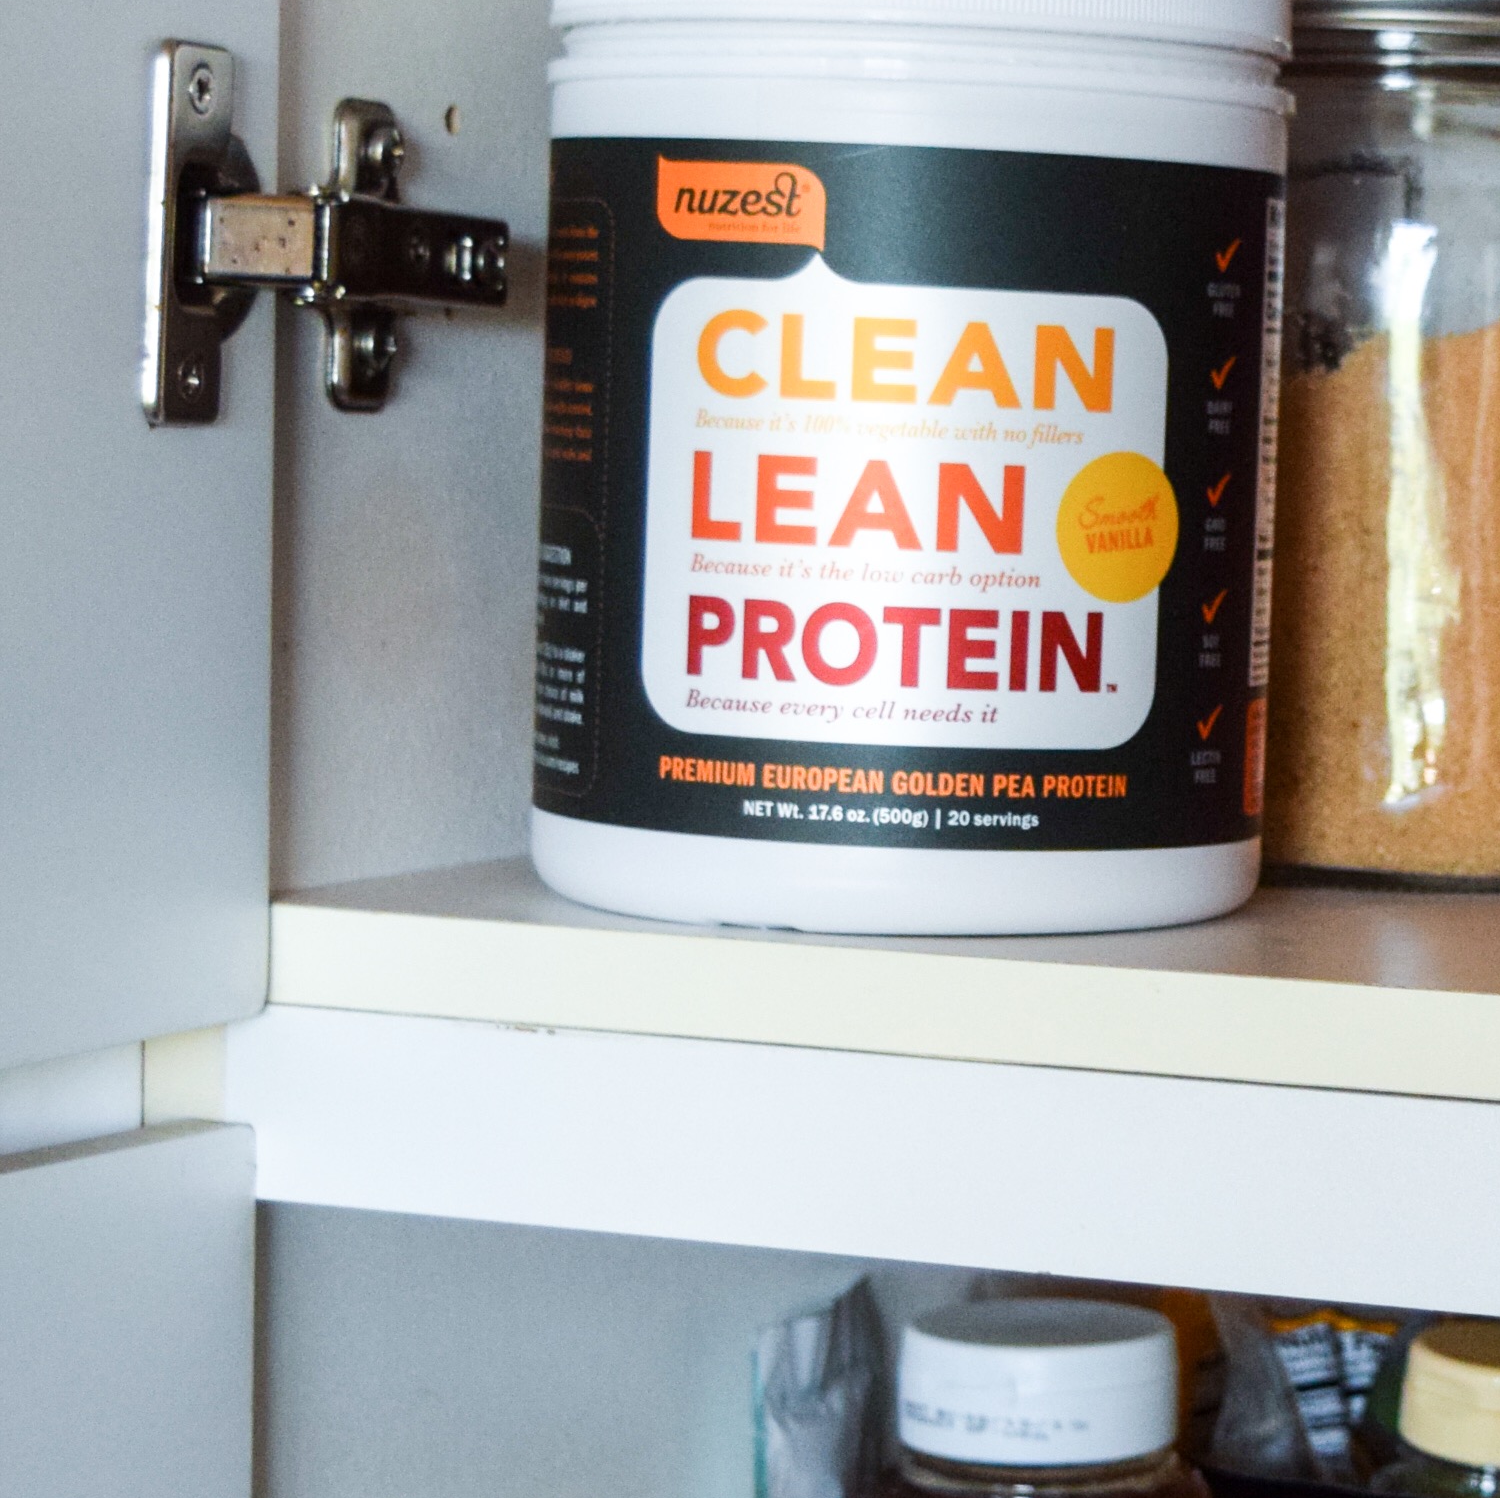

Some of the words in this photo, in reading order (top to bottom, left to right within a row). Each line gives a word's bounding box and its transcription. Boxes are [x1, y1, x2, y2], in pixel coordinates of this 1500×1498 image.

[674, 171, 801, 218] nuzest
[763, 221, 779, 233] for
[697, 309, 1115, 413] CLEAN
[695, 408, 764, 430] Because
[803, 413, 851, 436] 100%
[856, 416, 948, 444] vegetable
[954, 420, 997, 444] with
[1004, 427, 1027, 444] no
[1027, 423, 1084, 450] fillers
[691, 450, 1027, 556] LEAN
[1085, 526, 1155, 555] VANILLA
[689, 553, 773, 578] Because
[778, 558, 812, 580] it's
[819, 559, 855, 583] the
[860, 563, 905, 584] low
[910, 564, 963, 587] carb
[969, 567, 1042, 594] option
[687, 594, 1104, 694] PROTEIN
[685, 688, 773, 715] Because
[779, 698, 846, 724] every
[852, 700, 897, 721] cell
[902, 702, 974, 724] needs
[980, 703, 999, 724] it
[658, 754, 757, 788] PREMIUM
[762, 762, 886, 795] EUROPEAN
[890, 769, 986, 798] GOLDEN
[992, 773, 1037, 799] PEA
[1041, 774, 1128, 799] PROTEIN
[742, 799, 775, 818] NET
[776, 801, 805, 820] Wt.
[808, 803, 845, 822] 17.6
[845, 809, 871, 824] oz.
[872, 807, 930, 829] (500g)
[946, 810, 971, 828] 20
[973, 811, 1041, 831] servings
